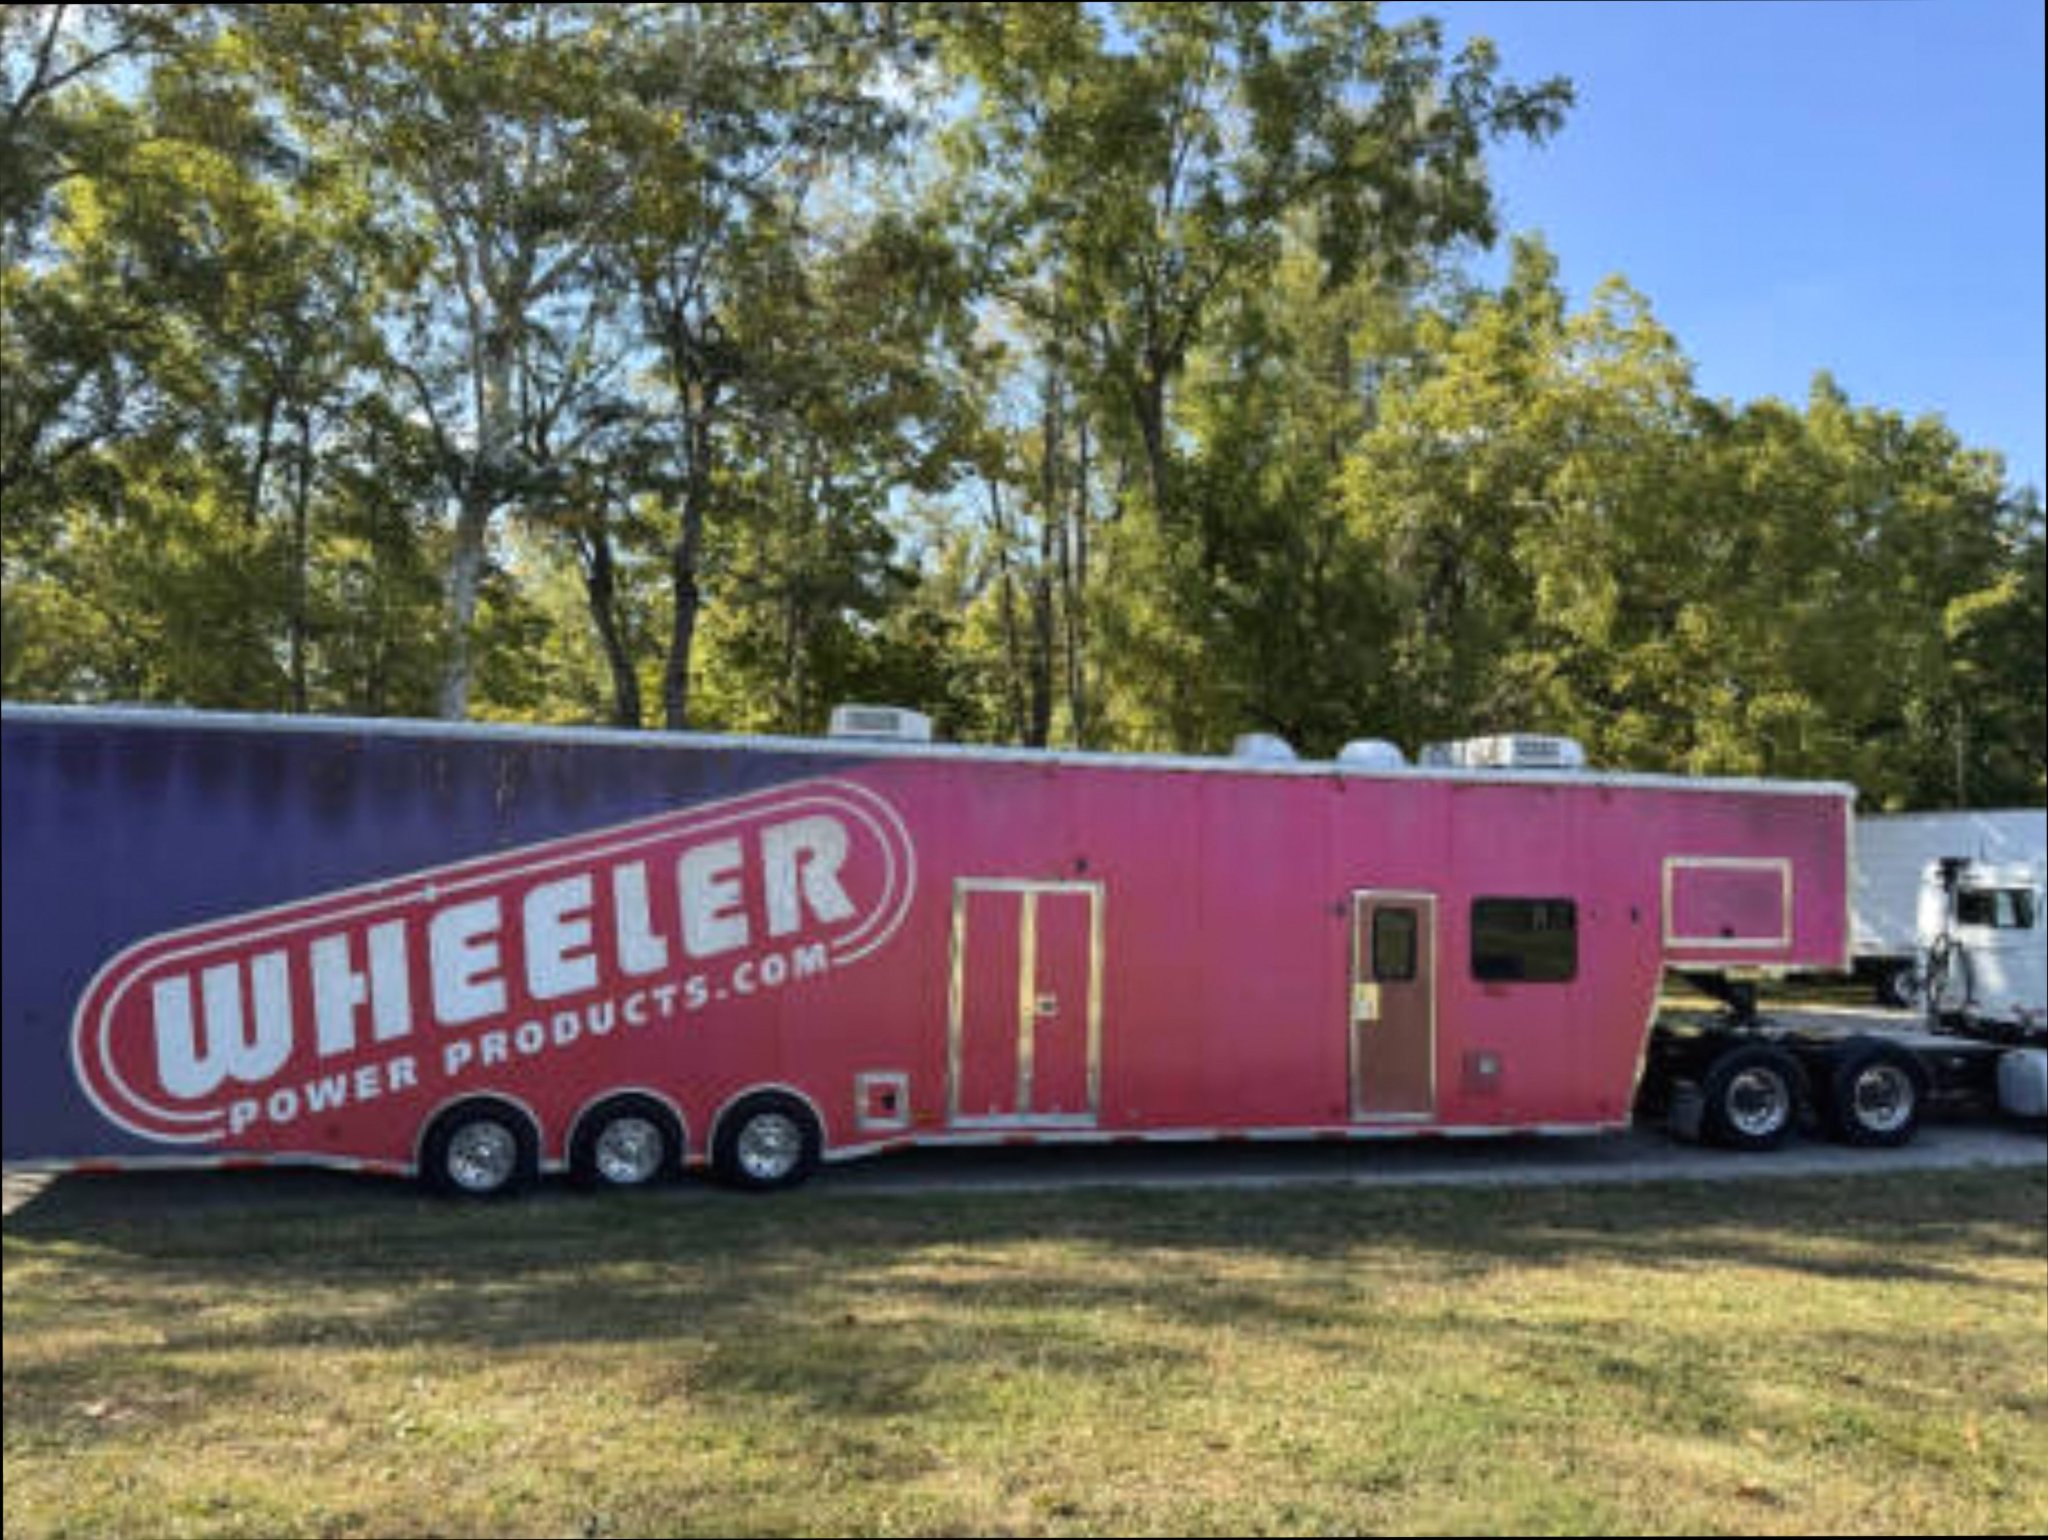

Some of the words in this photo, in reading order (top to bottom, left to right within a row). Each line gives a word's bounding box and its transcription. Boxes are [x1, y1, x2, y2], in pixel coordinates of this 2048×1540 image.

[152, 815, 857, 1099] WHEELER
[228, 1061, 419, 1136] POWER
[444, 942, 833, 1077] PRODUCTS.COM
